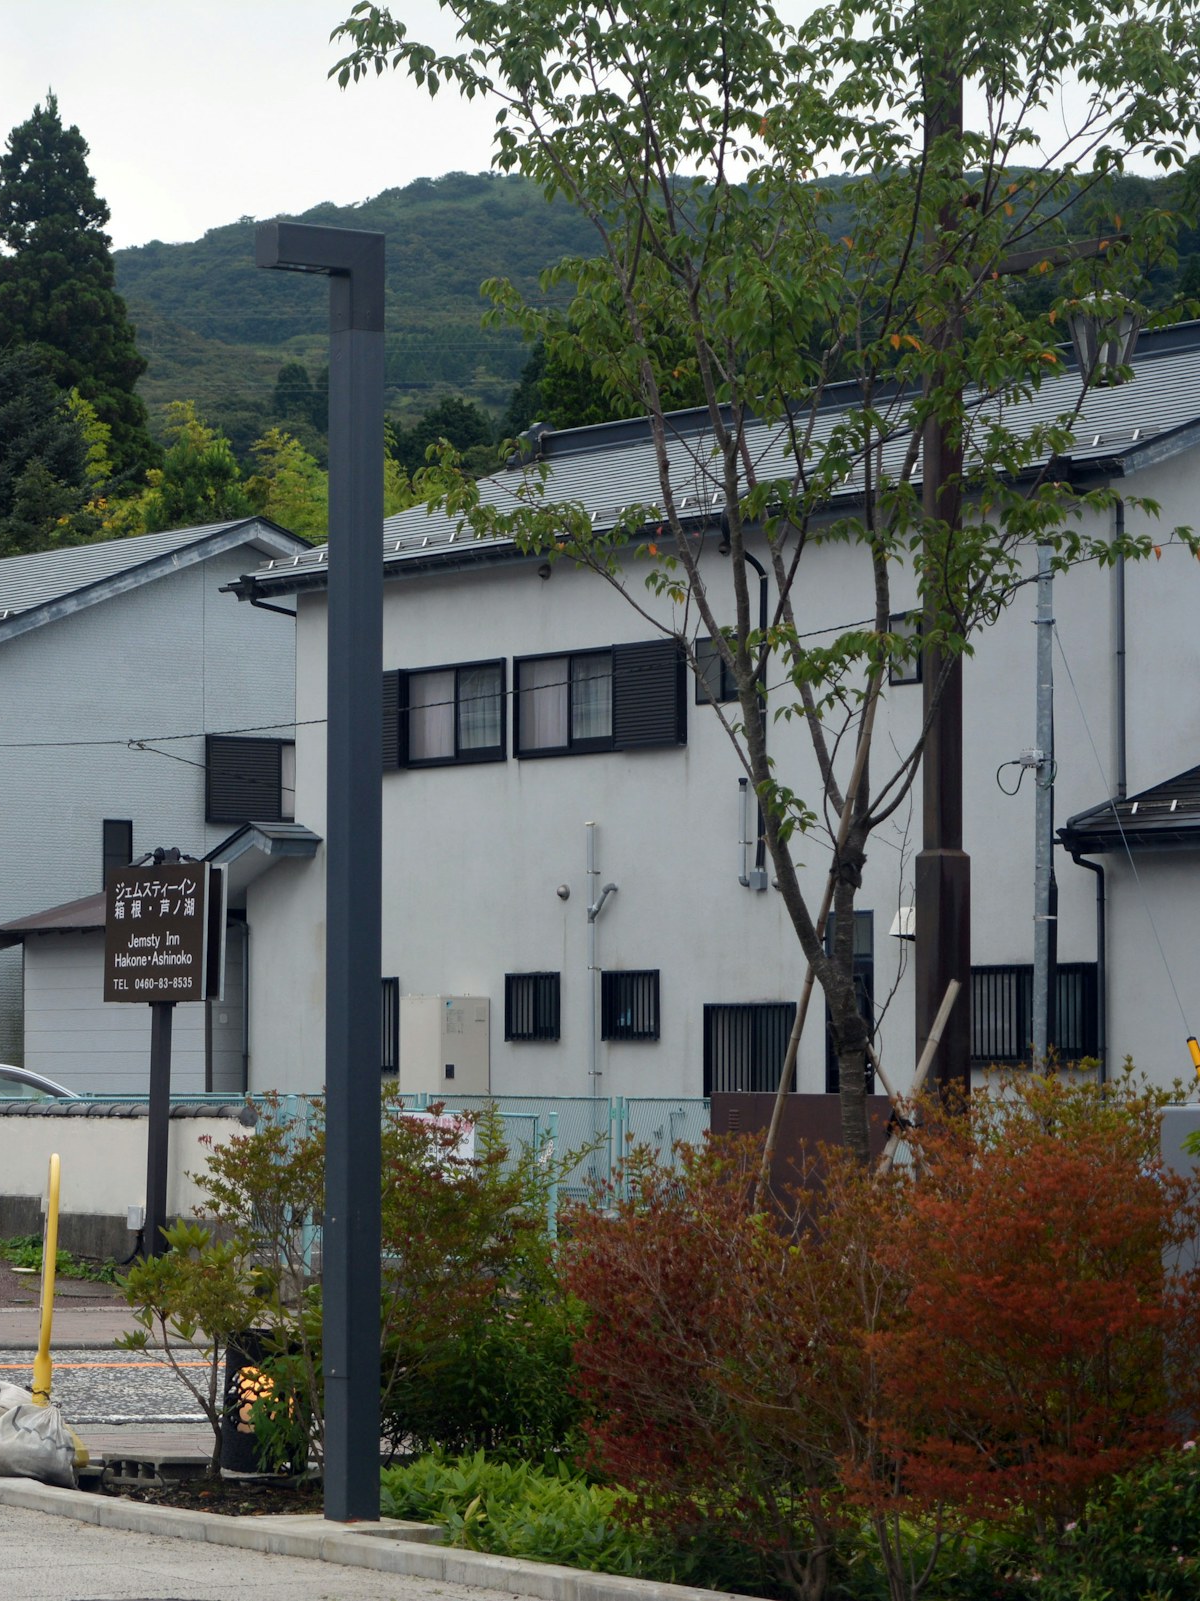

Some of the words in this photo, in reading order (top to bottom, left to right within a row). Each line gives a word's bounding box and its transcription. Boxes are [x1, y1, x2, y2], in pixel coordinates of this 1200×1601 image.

[115, 878, 196, 900] ジェムスティーイン
[128, 933, 160, 949] Jemsty
[166, 931, 180, 946] Inn
[113, 979, 129, 990] TEL
[135, 977, 193, 989] 0460-83-8535
